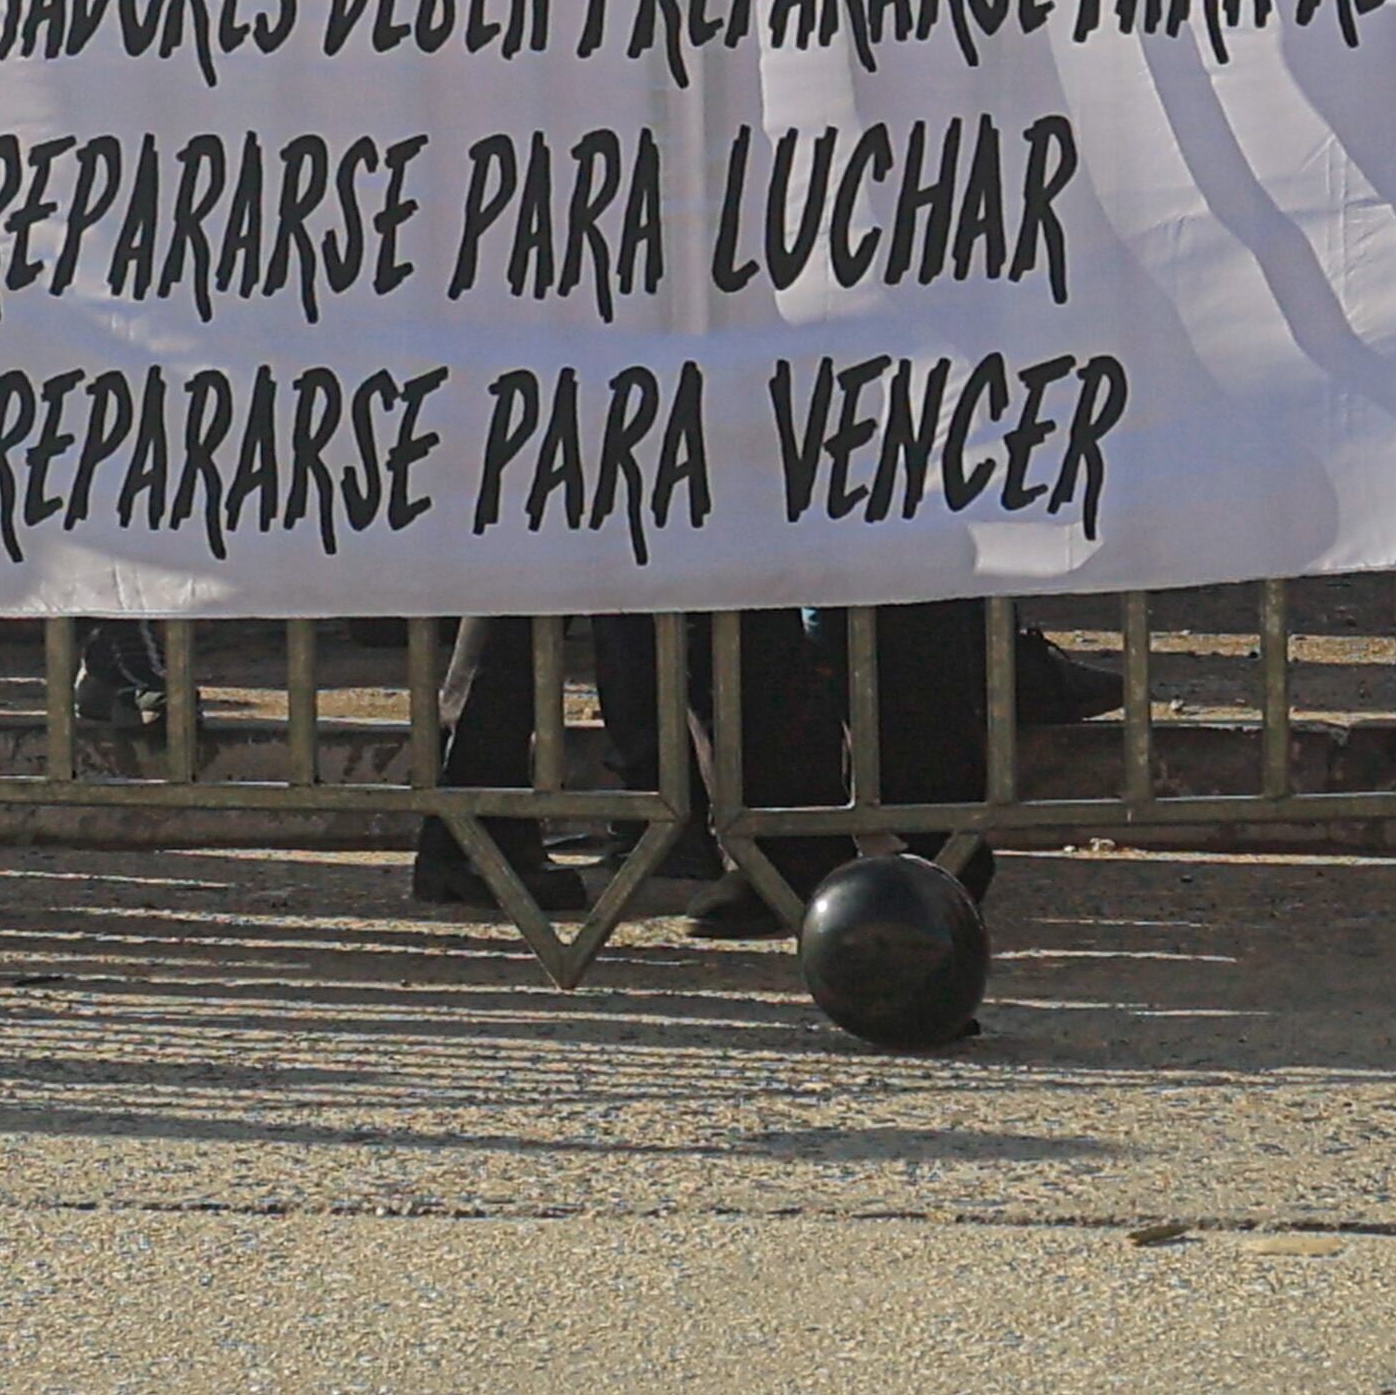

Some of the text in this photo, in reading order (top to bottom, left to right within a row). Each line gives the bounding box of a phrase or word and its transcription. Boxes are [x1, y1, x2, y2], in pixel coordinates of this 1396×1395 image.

[447, 127, 664, 324] PARA
[711, 113, 1078, 305] LUCHAR
[472, 360, 712, 566] PARA
[768, 351, 1128, 541] VENCER
